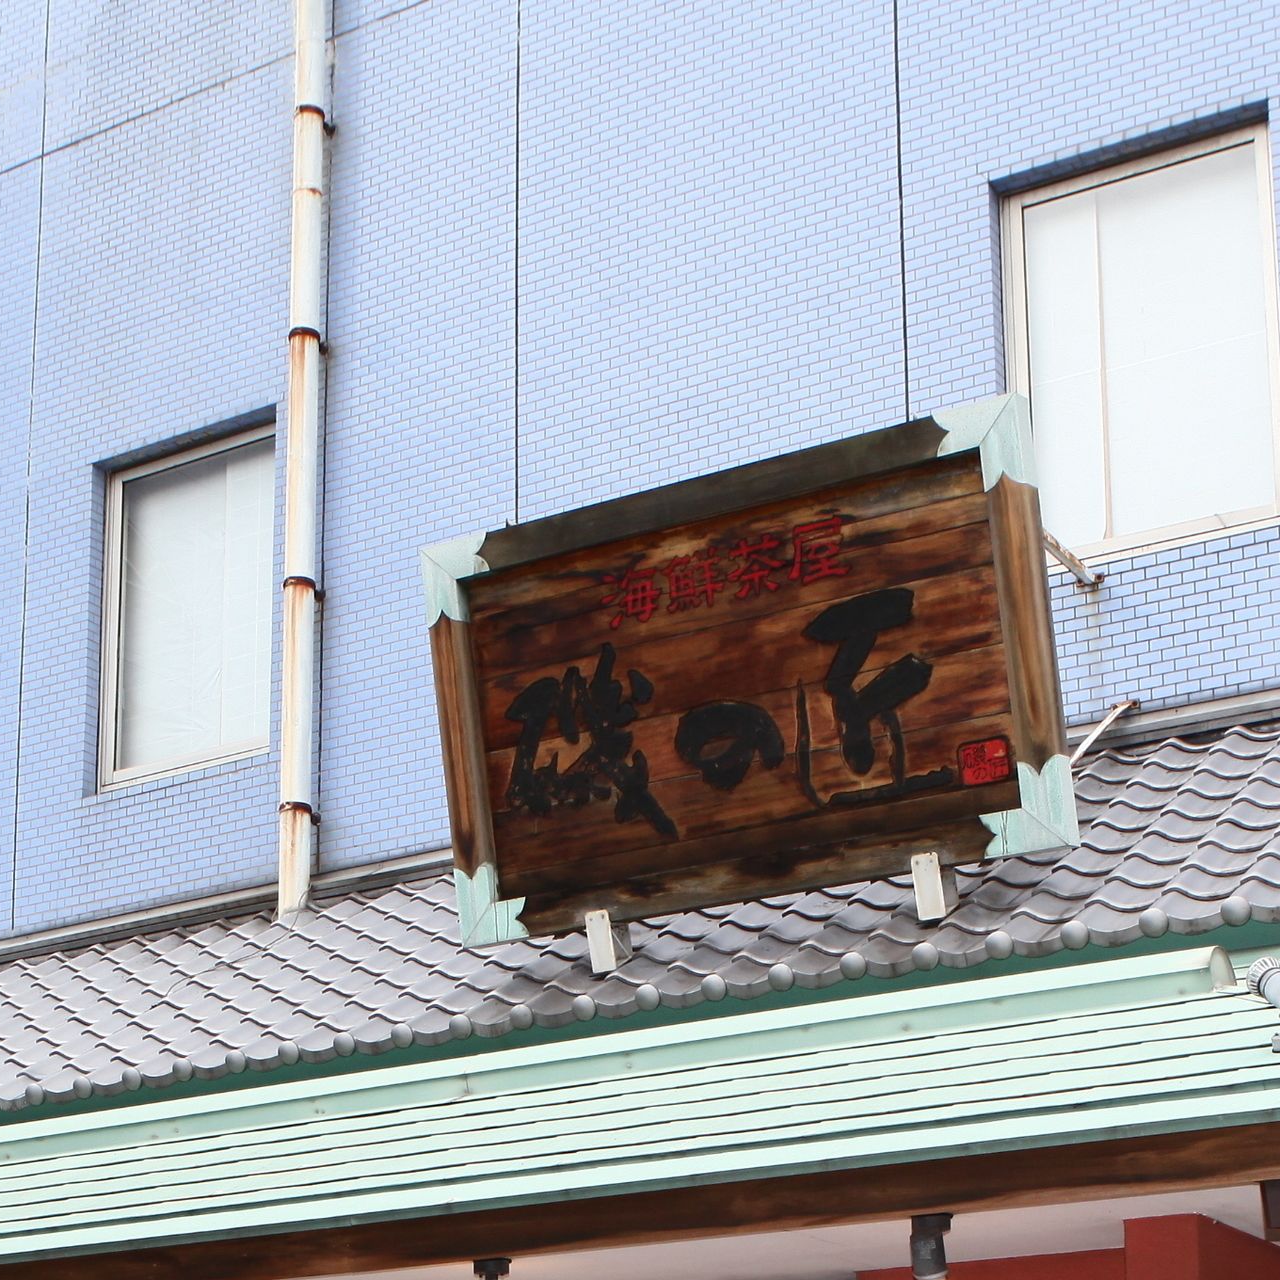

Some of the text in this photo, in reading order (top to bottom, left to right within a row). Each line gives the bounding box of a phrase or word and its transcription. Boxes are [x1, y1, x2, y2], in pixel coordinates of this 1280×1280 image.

[601, 515, 852, 629] 海鮮茶屋
[505, 587, 956, 840] 磯の匠
